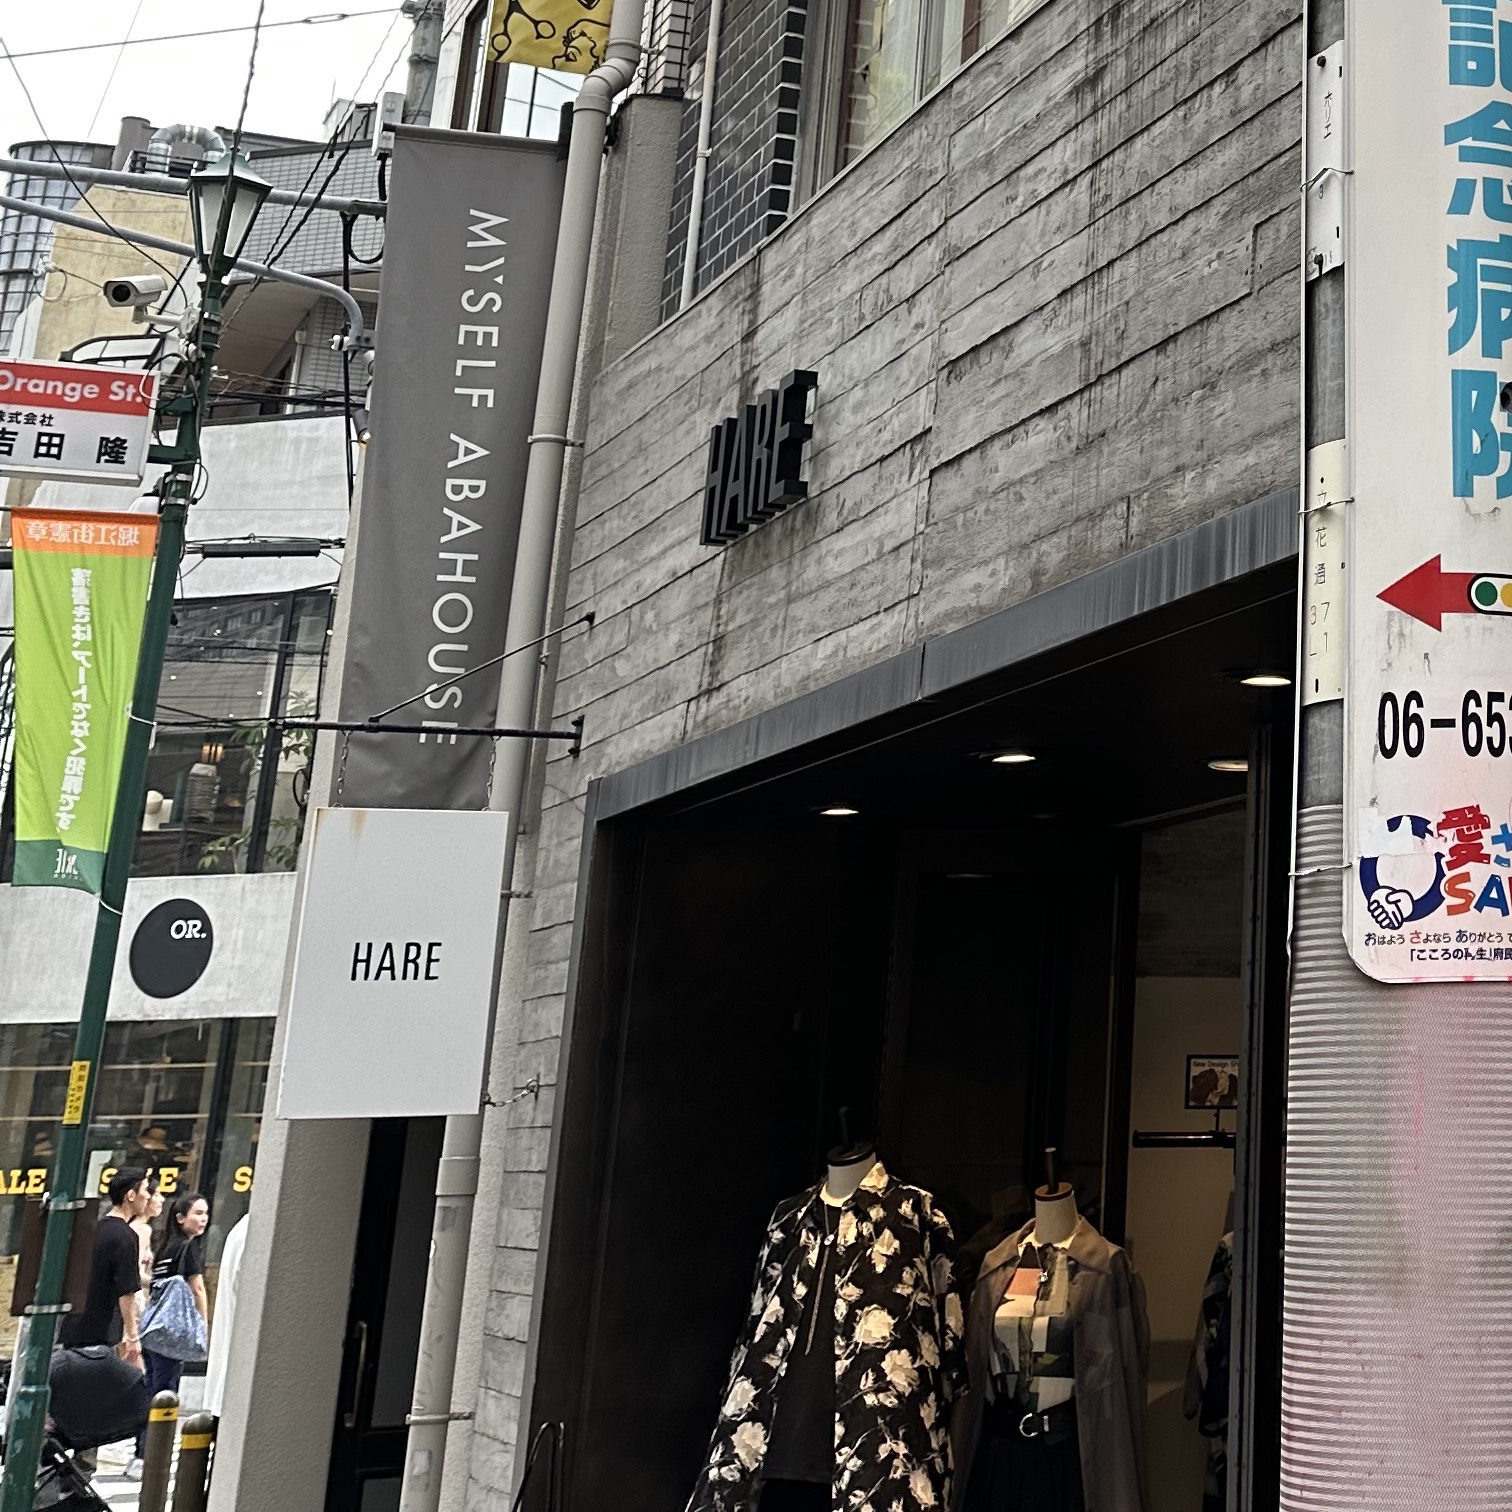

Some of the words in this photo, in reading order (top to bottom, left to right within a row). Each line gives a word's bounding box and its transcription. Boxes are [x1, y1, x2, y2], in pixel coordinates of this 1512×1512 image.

[0, 369, 99, 403] Orange
[109, 380, 143, 403] St.
[700, 368, 819, 547] HARE
[418, 432, 492, 745] ABAHOUSE
[170, 919, 207, 940] OR.
[1364, 932, 1405, 946] おはよう
[1409, 930, 1452, 944] さよなら
[1455, 929, 1504, 944] ありがとう
[350, 942, 443, 982] HARE
